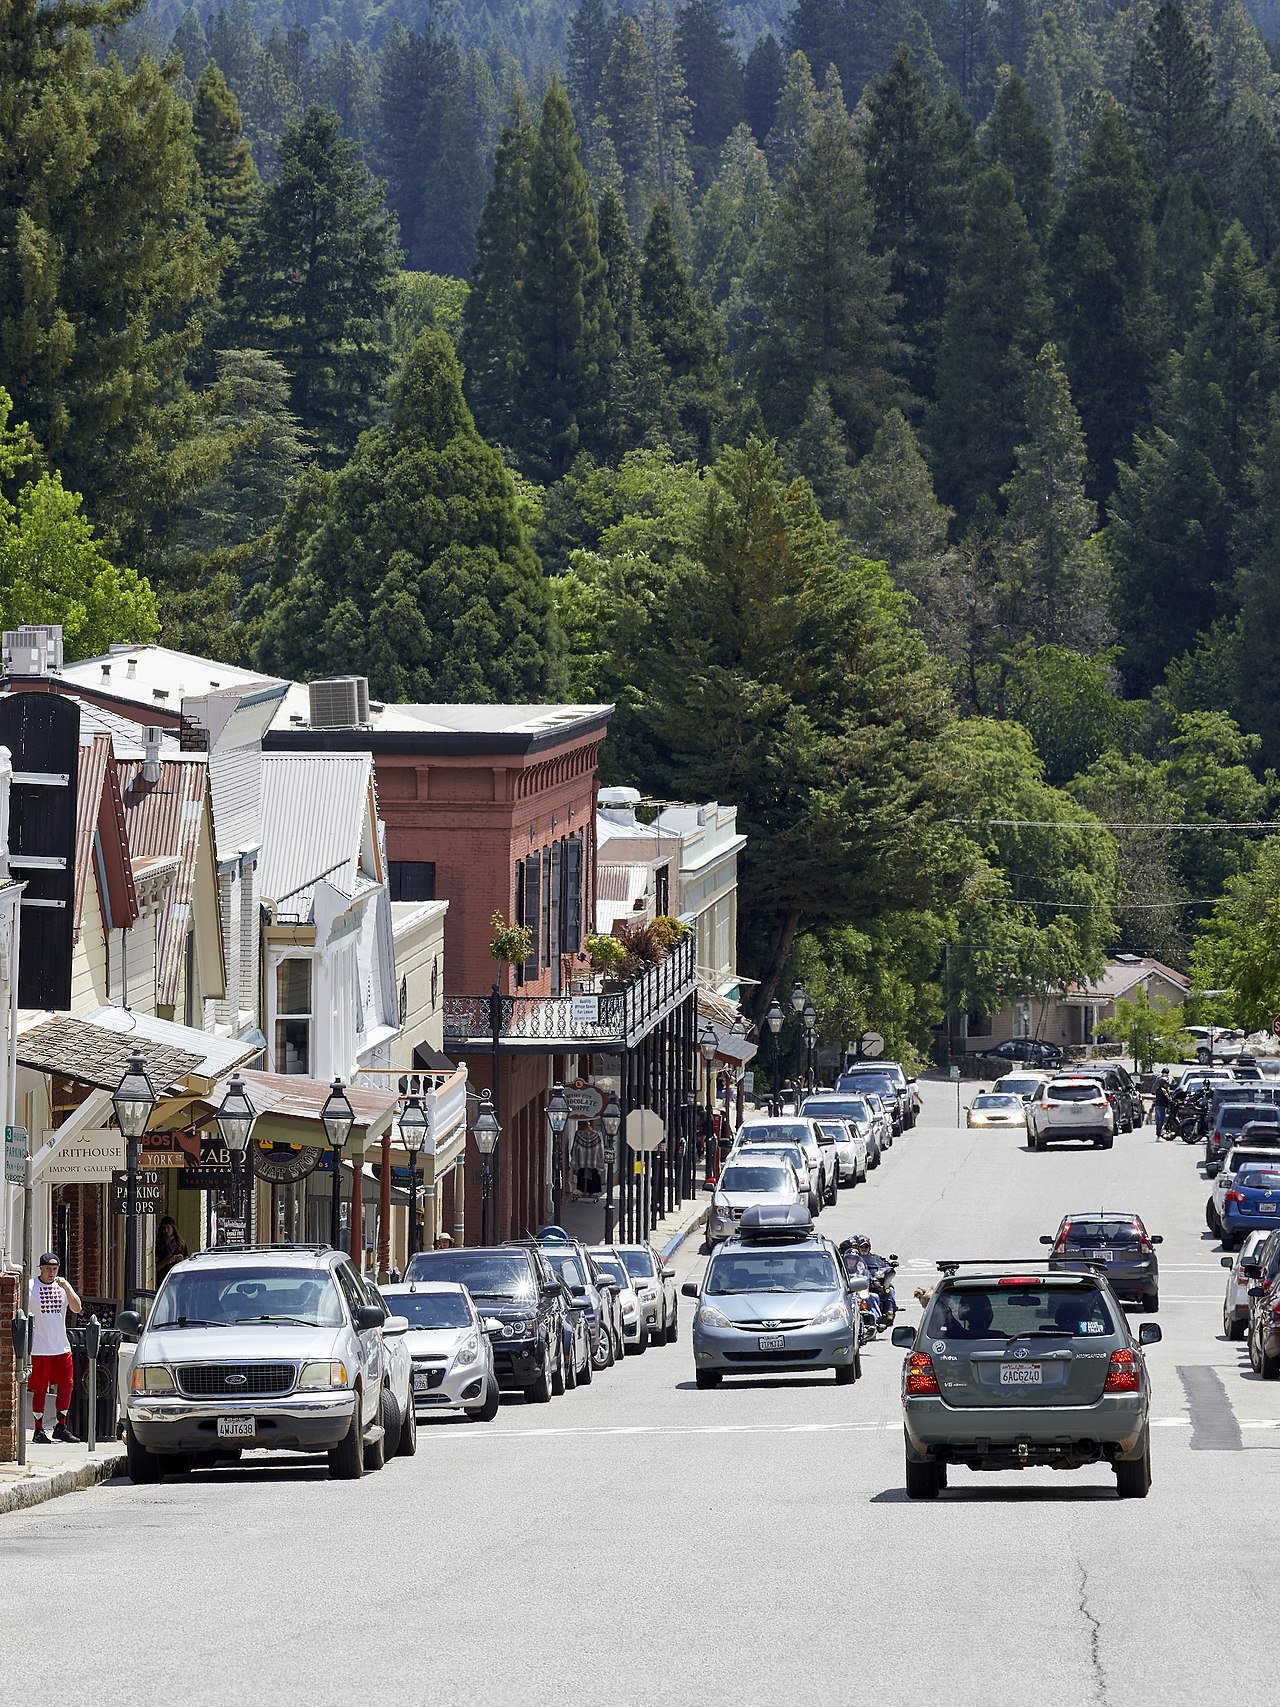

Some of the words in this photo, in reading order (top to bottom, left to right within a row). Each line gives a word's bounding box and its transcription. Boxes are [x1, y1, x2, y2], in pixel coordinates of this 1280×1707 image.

[6, 1128, 12, 1140] 3
[147, 1154, 173, 1166] YORK
[288, 1146, 319, 1179] STOR
[49, 1165, 81, 1173] IMPORT
[84, 1165, 119, 1173] GALLERY
[145, 1172, 158, 1183] TO
[116, 1186, 160, 1199] PAKING
[121, 1201, 154, 1213] SOPS
[1002, 1370, 1040, 1382] 6ACG240
